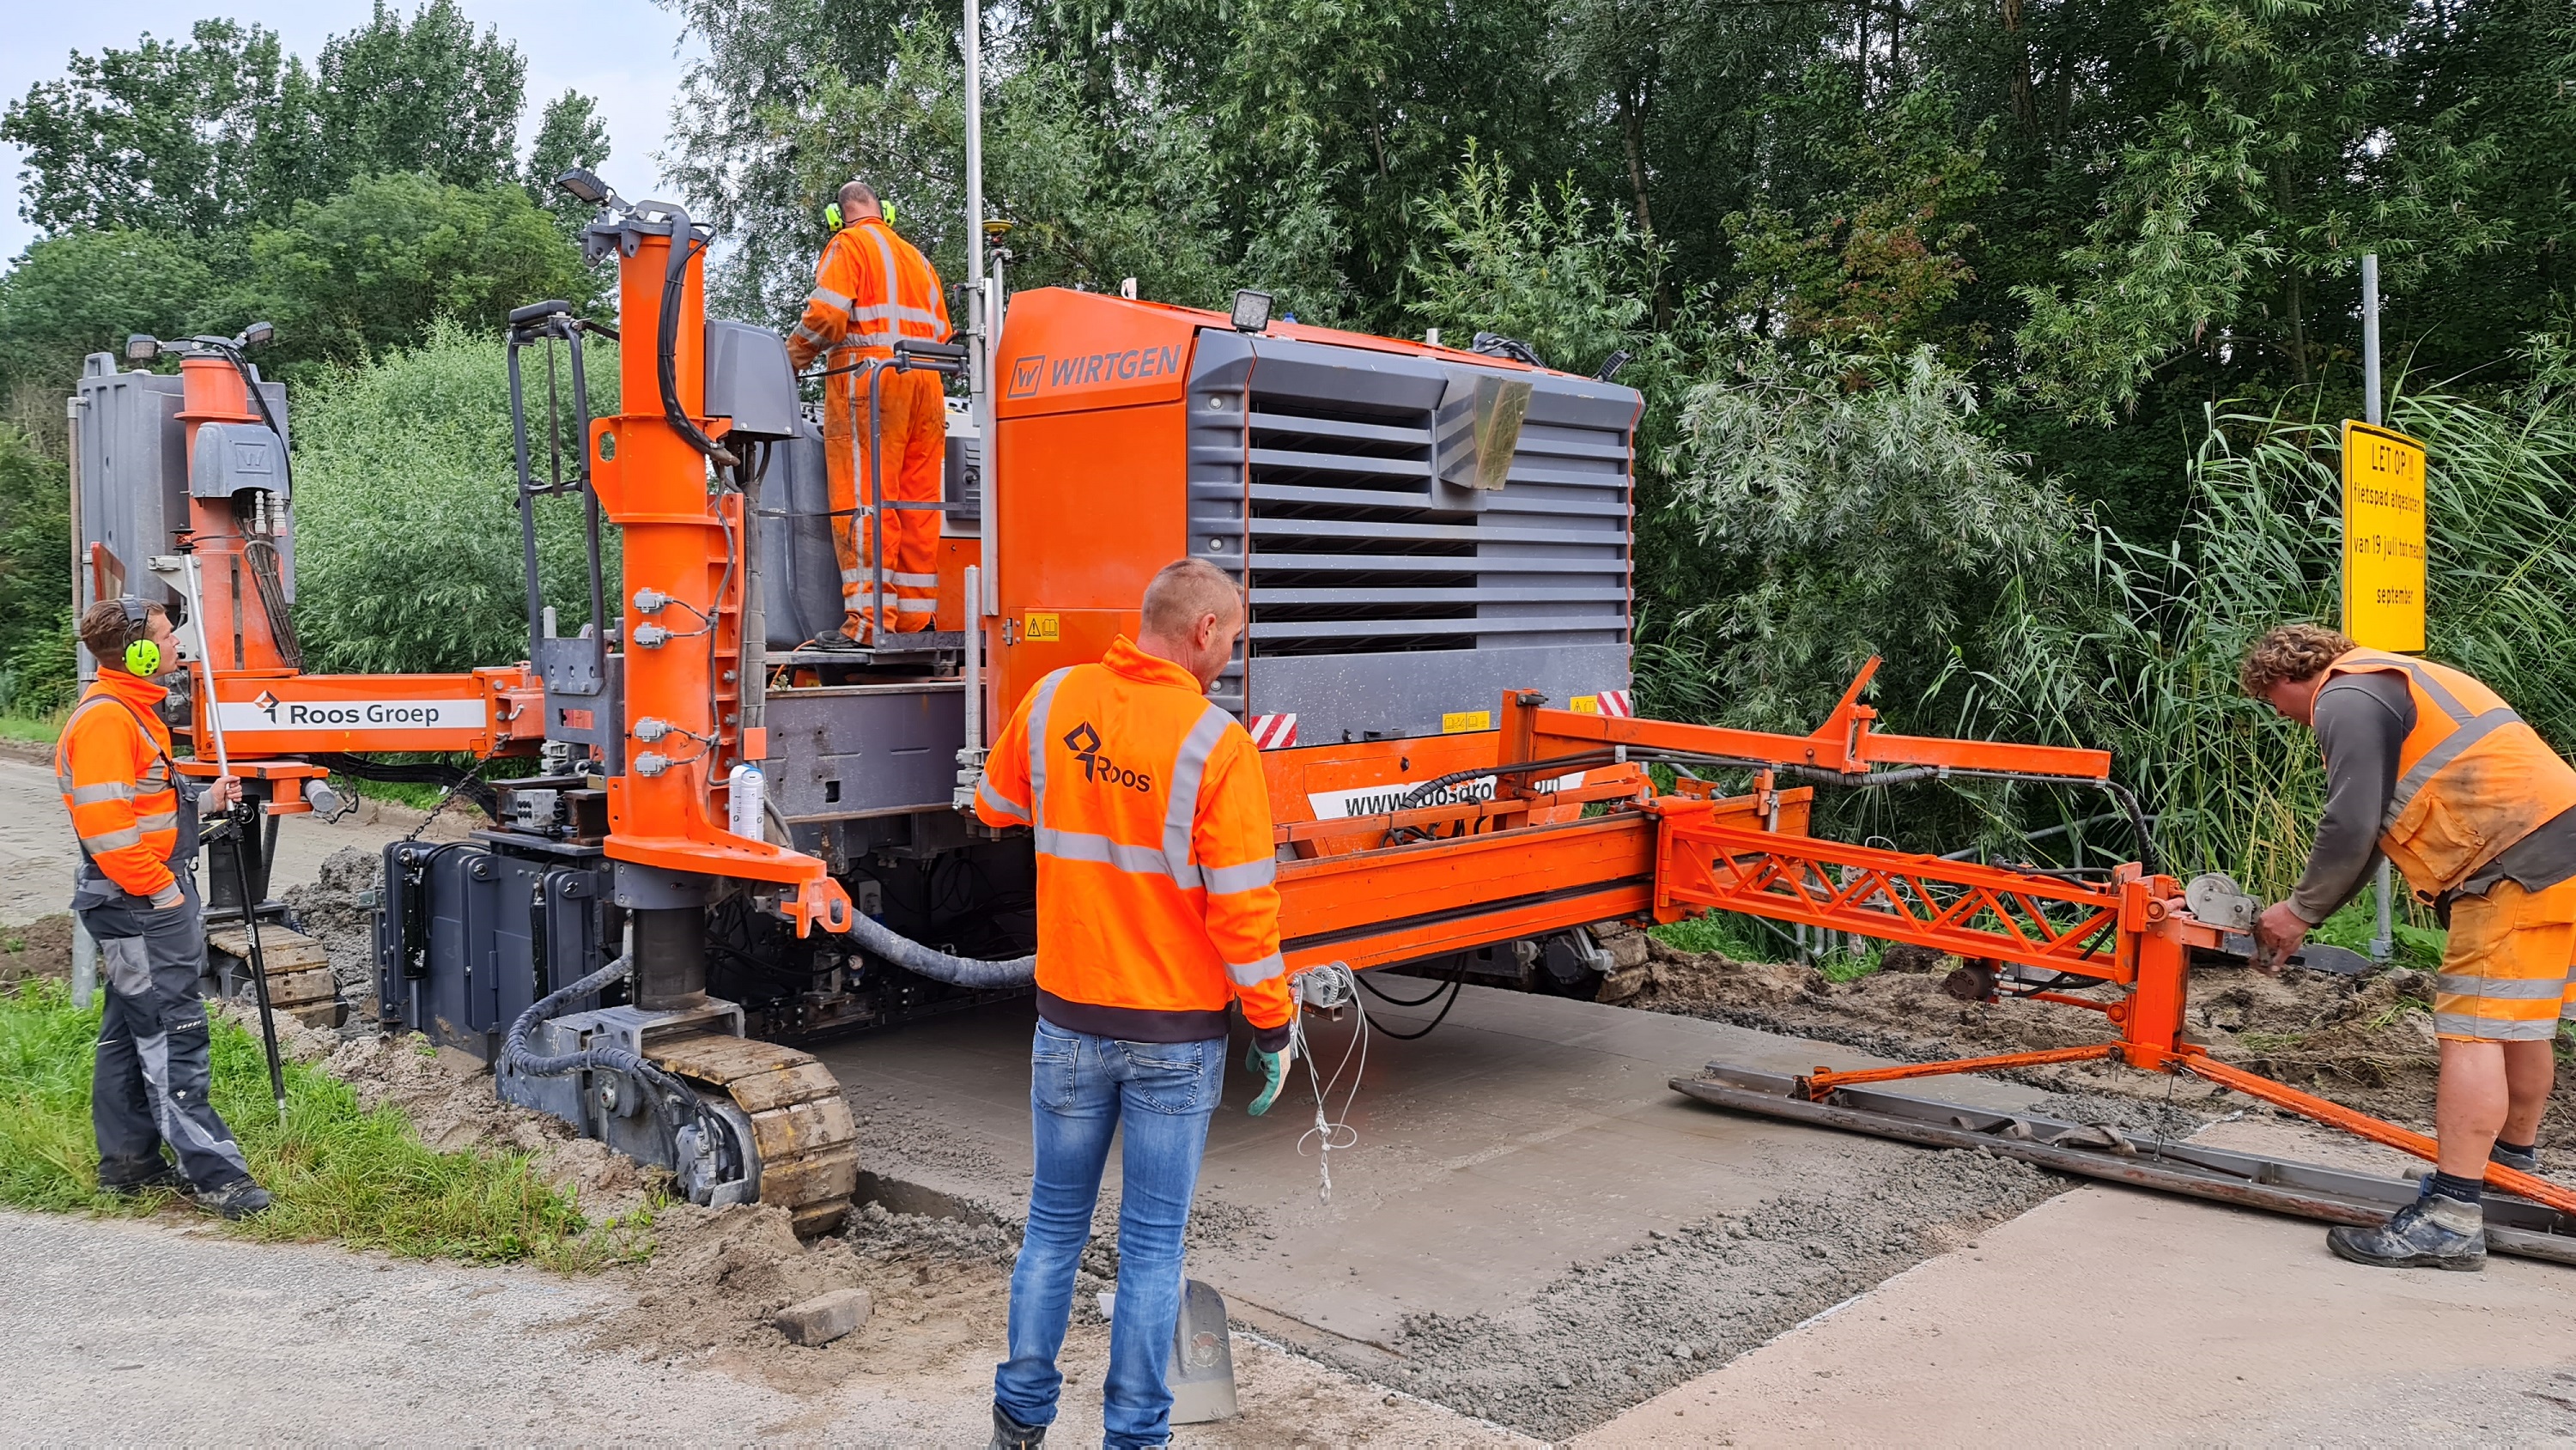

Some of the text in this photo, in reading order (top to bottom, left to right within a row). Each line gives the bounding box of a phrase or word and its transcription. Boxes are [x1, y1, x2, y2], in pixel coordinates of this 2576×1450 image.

[1052, 344, 1182, 387] WIRTGEN
[2372, 443, 2391, 473] LET
[2394, 449, 2407, 476] OP
[2354, 482, 2389, 509] fietspad
[2354, 537, 2369, 554] van
[2372, 534, 2381, 555] 19
[2384, 536, 2397, 561] juli
[2399, 538, 2408, 557] tot
[2377, 585, 2414, 608] september
[290, 704, 440, 727] Roos Groep
